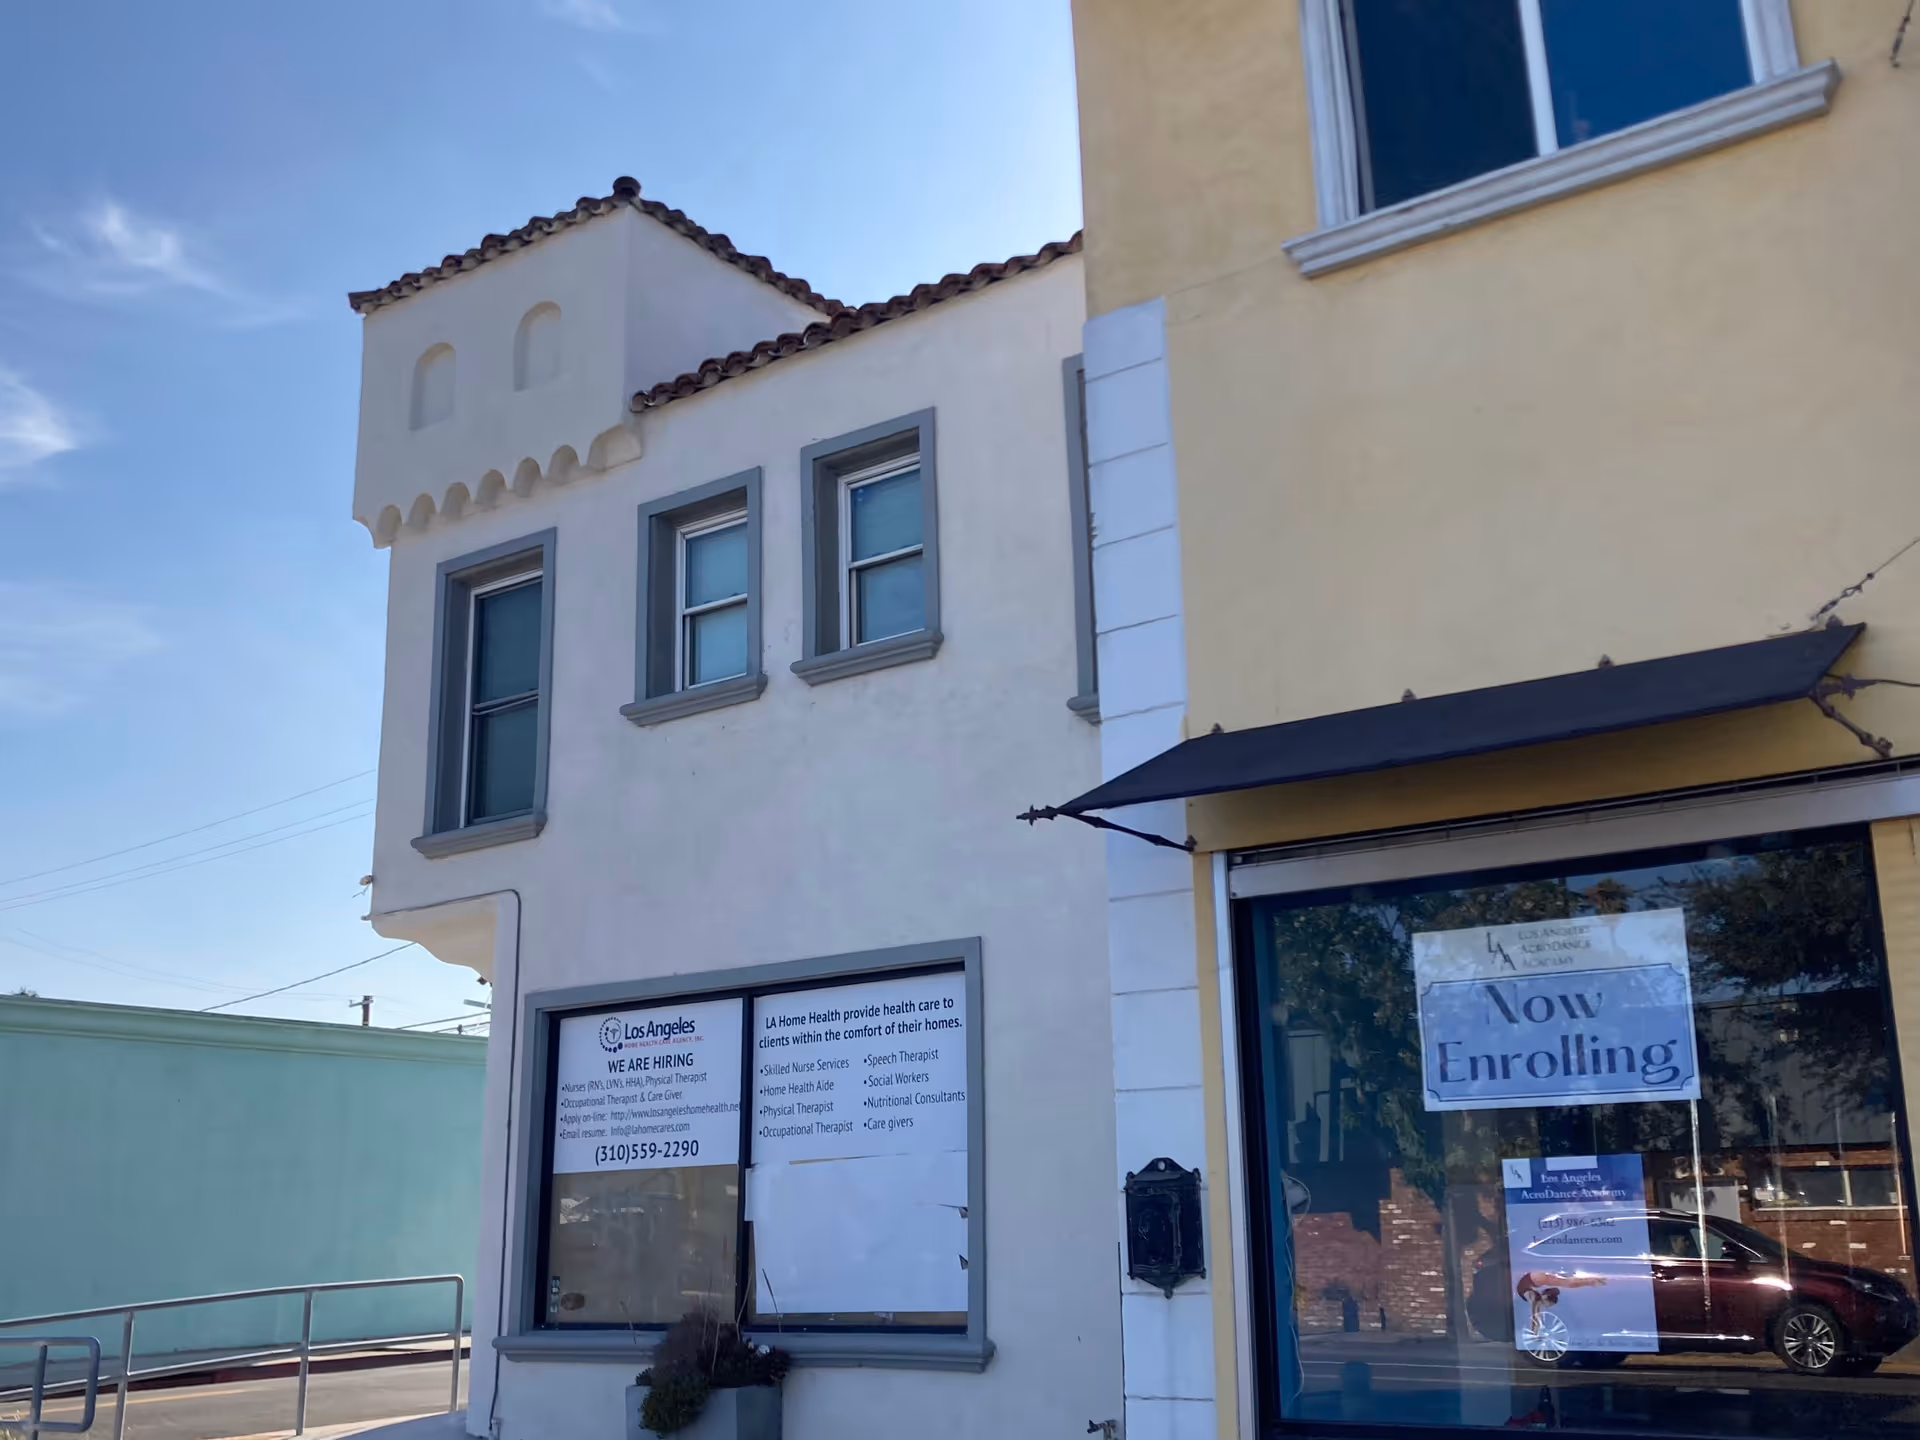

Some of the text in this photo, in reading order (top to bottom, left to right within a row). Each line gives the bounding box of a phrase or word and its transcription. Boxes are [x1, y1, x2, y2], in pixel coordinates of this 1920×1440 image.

[766, 997, 954, 1029] LA Home Health provide health care to
[1486, 984, 1602, 1024] Now
[625, 1016, 695, 1040] Los Angeles
[759, 1016, 962, 1049] clients within the comfort of their homes.
[608, 1053, 693, 1073] WE ARE HIRING
[764, 1058, 850, 1076] Skilled Nurse Services
[867, 1048, 939, 1068] Speech Therapist
[1438, 1034, 1680, 1085] Enrolling
[565, 1083, 586, 1092] Nurses
[646, 1074, 673, 1088] Physical
[675, 1072, 707, 1085] Therapist
[763, 1079, 834, 1097] Home Health Aide
[868, 1071, 929, 1087] Social Workers
[564, 1089, 682, 1109] Occupational Therapist & Care Giver
[868, 1090, 965, 1109] Nutritional Consultants
[563, 1101, 740, 1124] Apply on-line: http://www.losangeleshomehealth.ne
[763, 1101, 834, 1119] Physical Therapist
[562, 1129, 580, 1139] Email
[581, 1128, 607, 1138] resume:
[763, 1120, 853, 1139] Occupational Therapist
[868, 1116, 913, 1131] Care givers
[595, 1140, 699, 1165] (310)559-2290
[1562, 1172, 1601, 1185] Angeles
[1521, 1189, 1577, 1200] AcroDance
